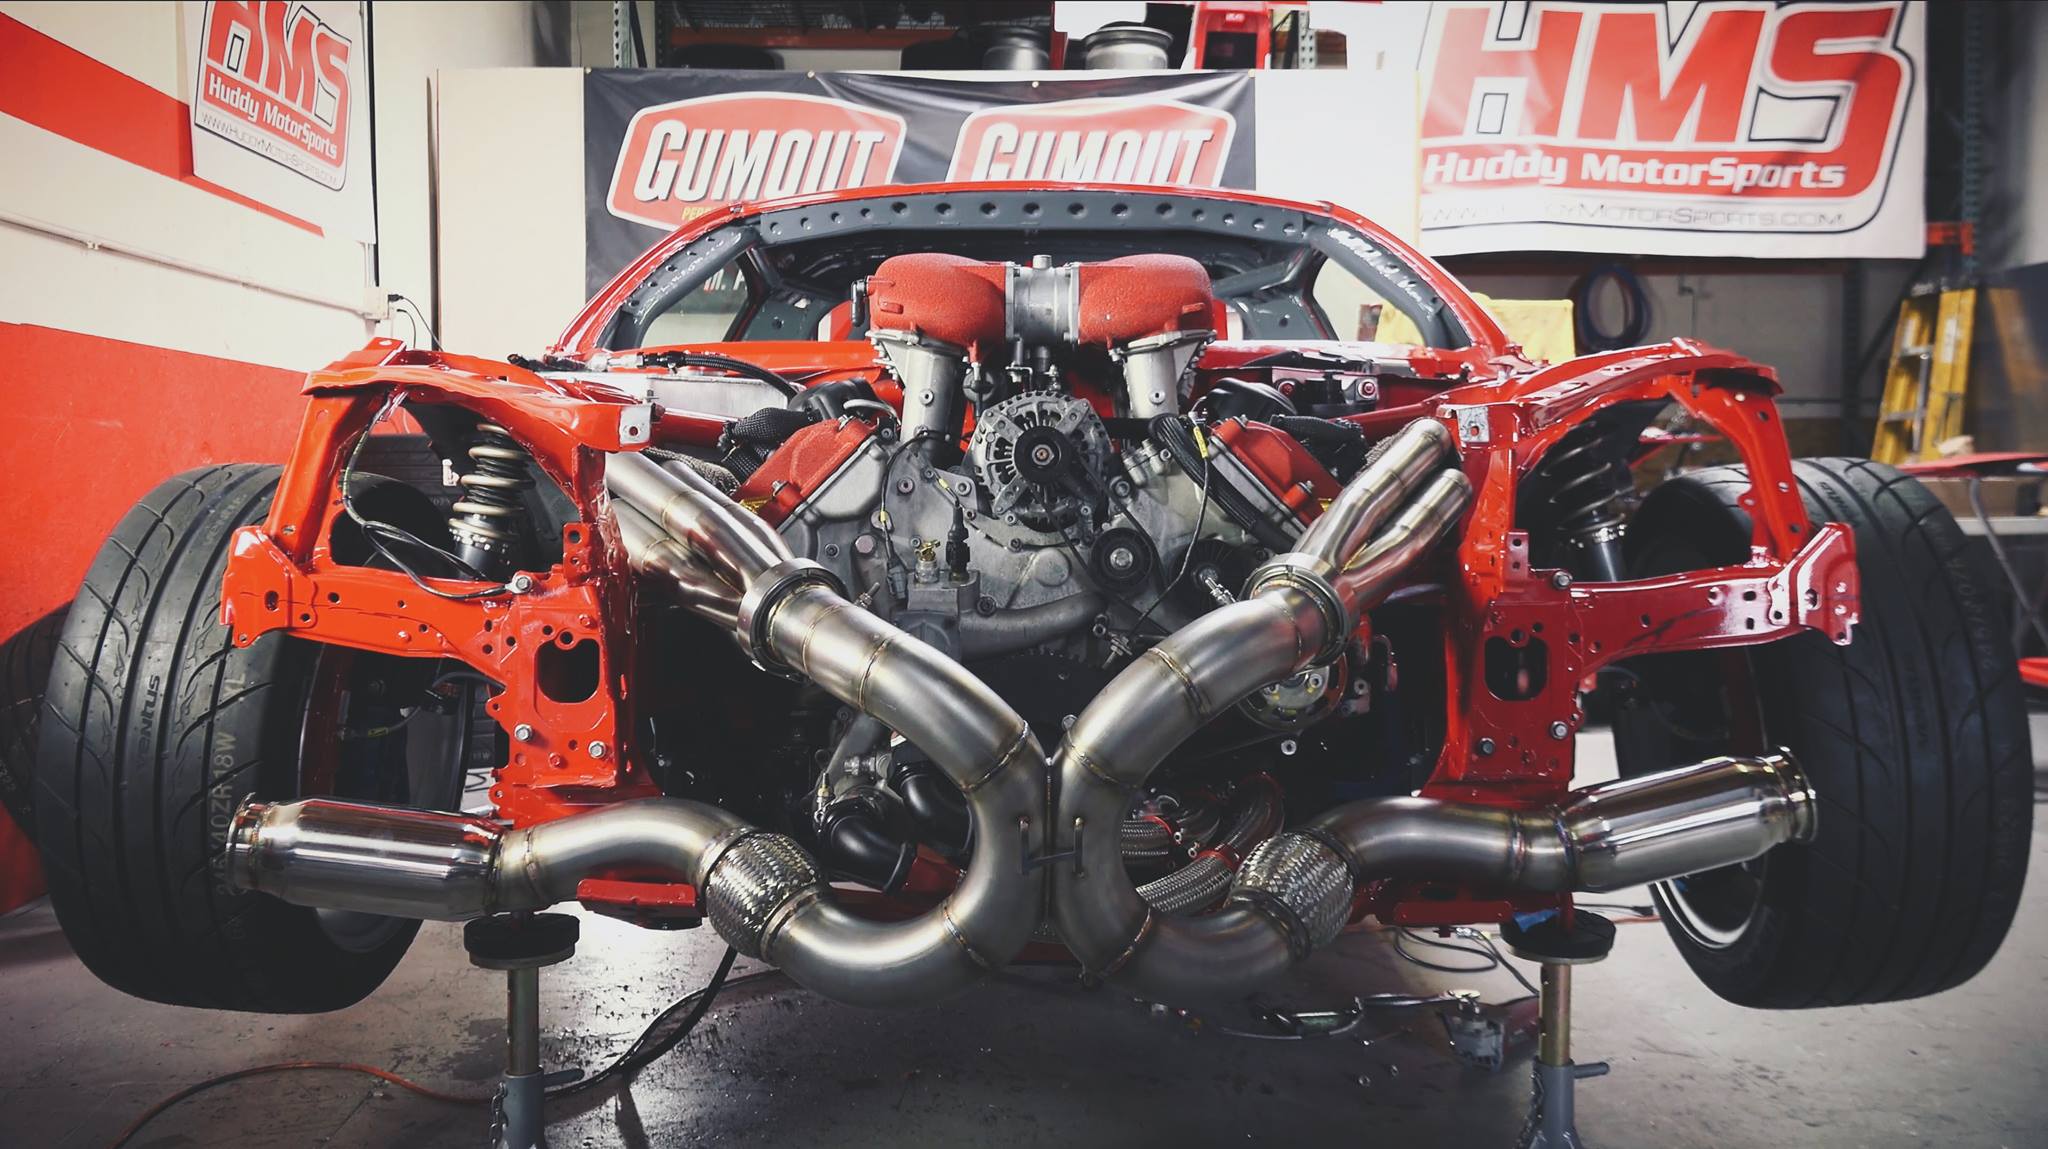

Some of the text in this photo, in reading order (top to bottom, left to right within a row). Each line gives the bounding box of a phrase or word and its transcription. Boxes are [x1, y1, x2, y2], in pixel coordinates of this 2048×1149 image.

[207, 1, 351, 117] HMS
[1421, 8, 1902, 148] HMS
[208, 72, 337, 160] Huddy MotorSports
[970, 122, 1215, 184] GUMOUT
[633, 119, 885, 202] GUMOUT
[1424, 150, 1847, 194] Huddy MotorSports
